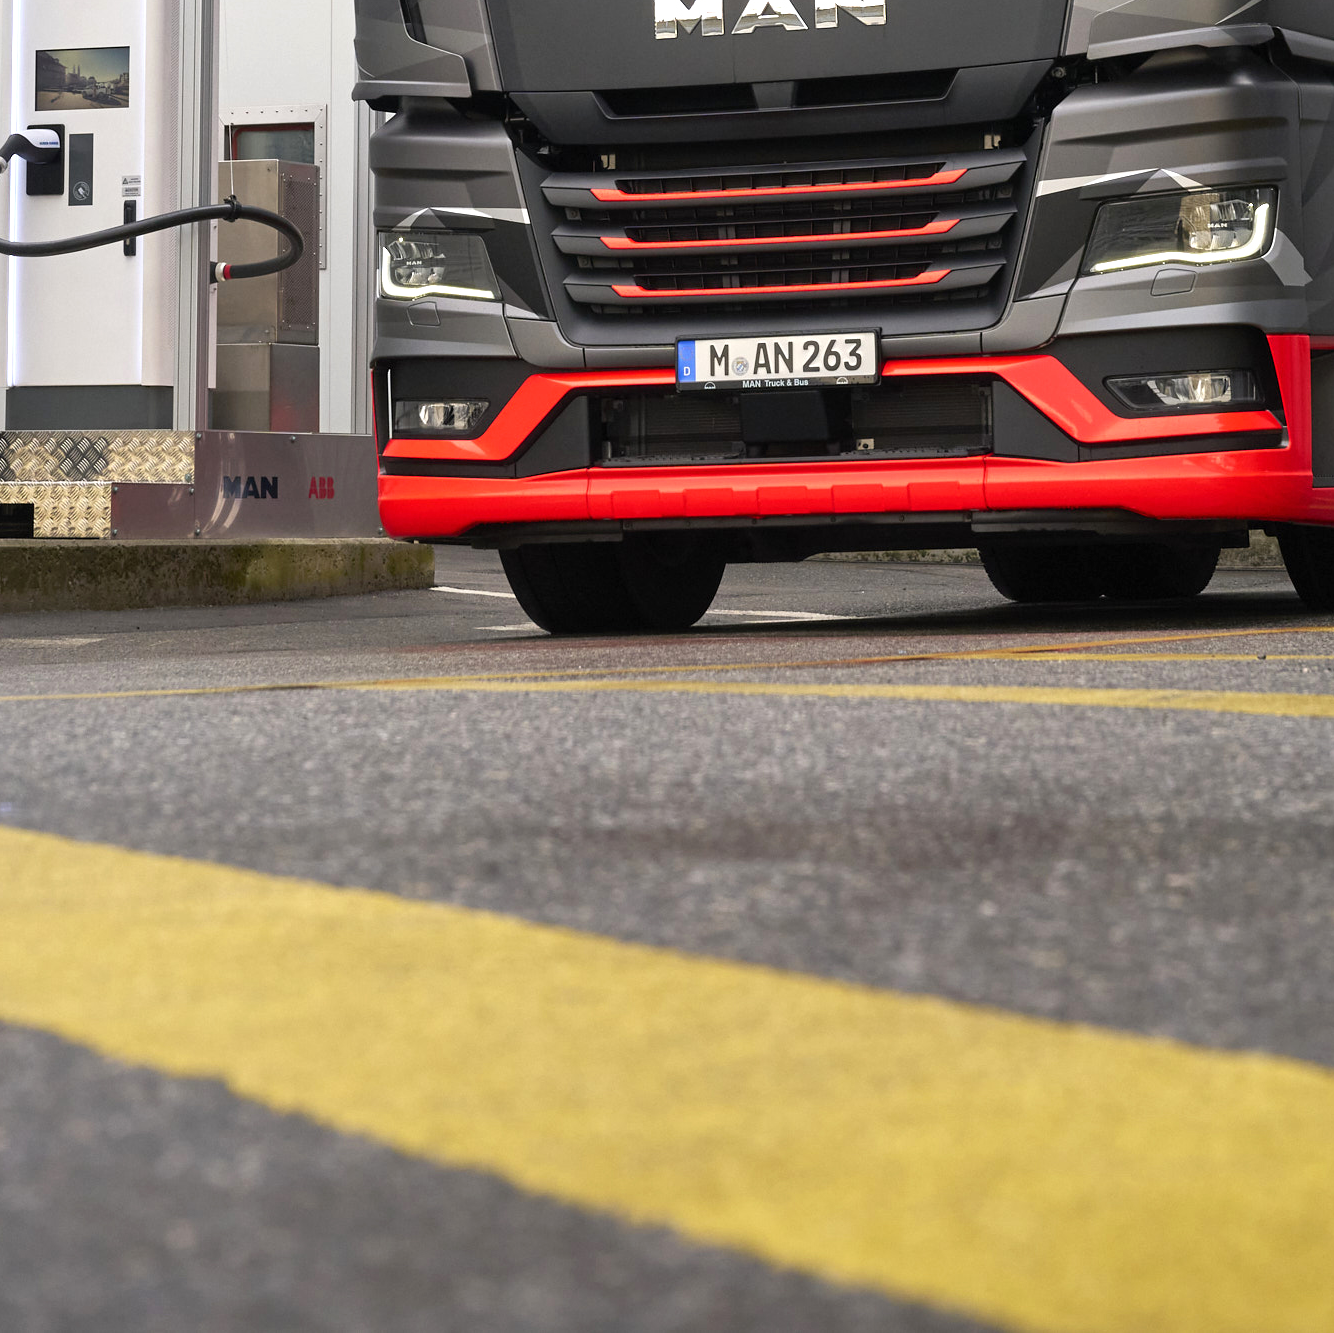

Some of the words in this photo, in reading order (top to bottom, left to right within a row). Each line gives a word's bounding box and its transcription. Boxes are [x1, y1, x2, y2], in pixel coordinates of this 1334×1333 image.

[710, 344, 729, 376] M
[753, 341, 793, 375] AN
[802, 338, 862, 373] 263
[683, 366, 691, 376] D
[742, 380, 761, 388] MAN
[764, 379, 785, 387] Truck
[793, 378, 809, 386] Bus
[223, 476, 279, 499] MAN
[308, 476, 335, 499] ABB
